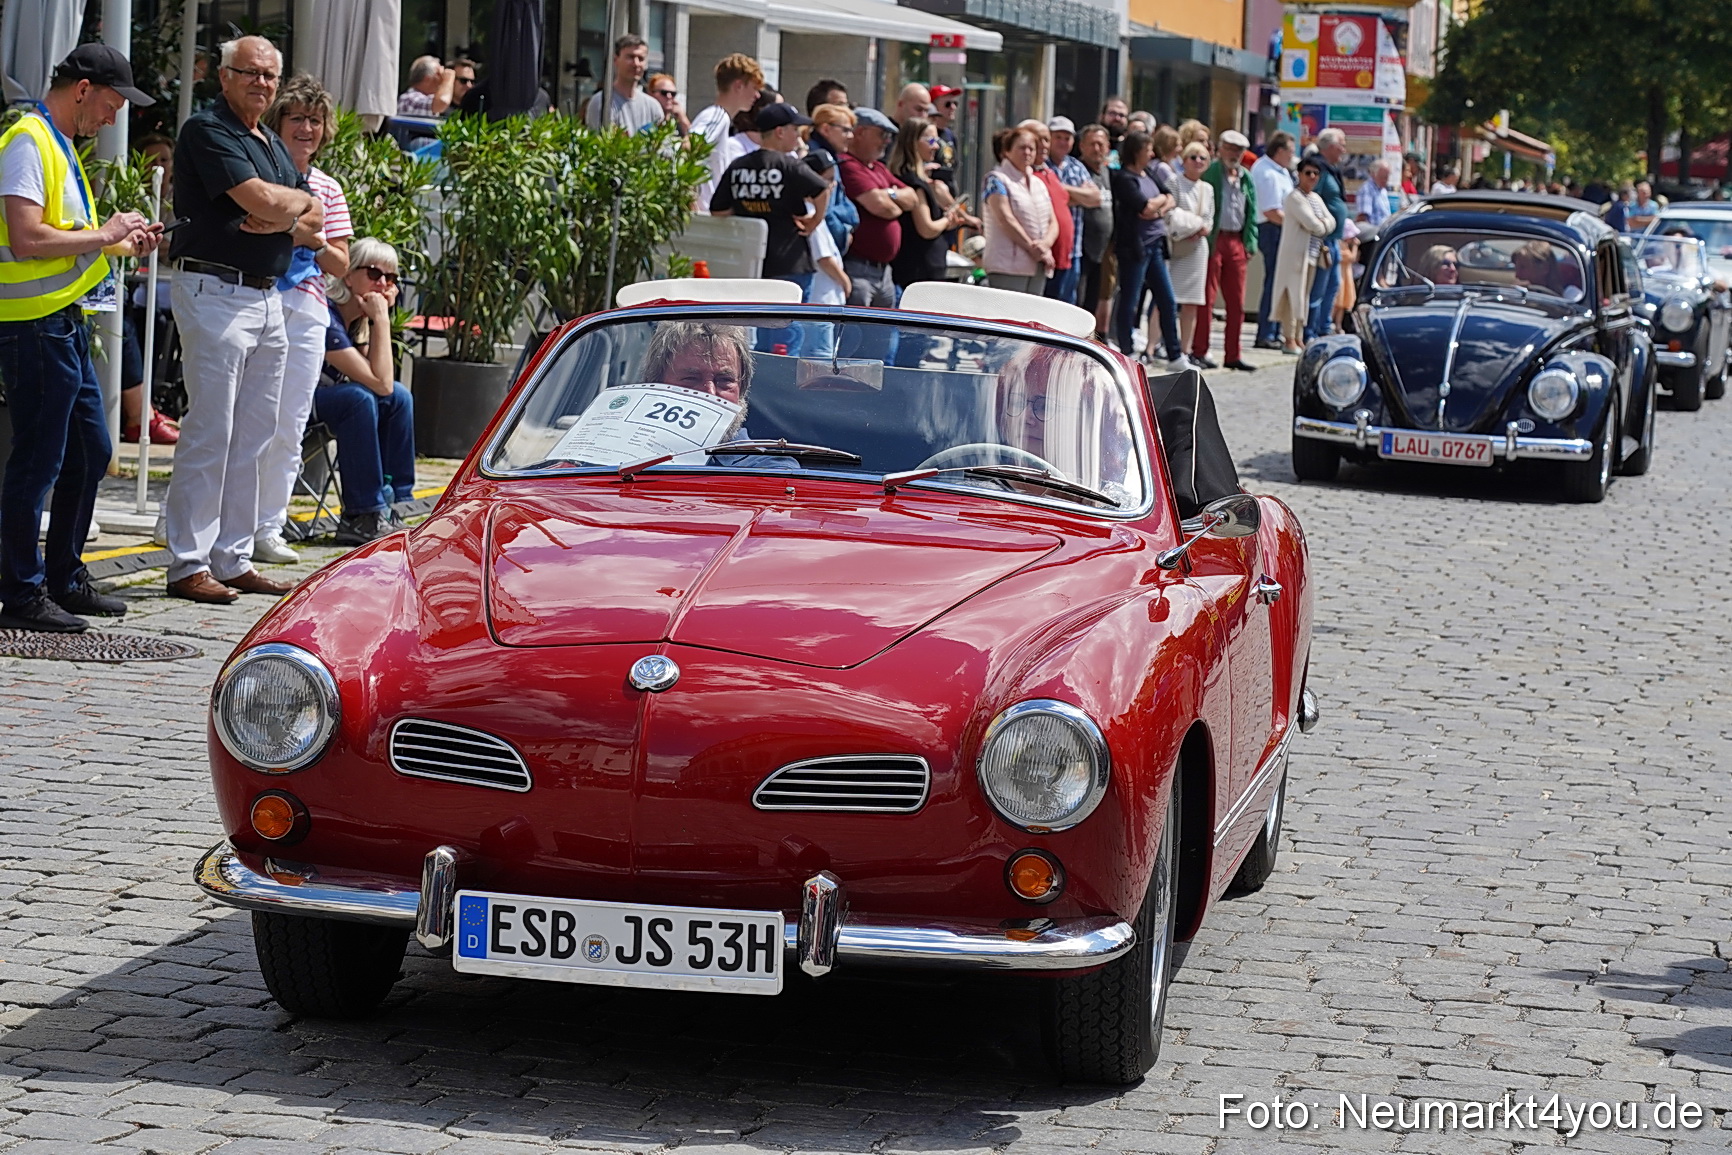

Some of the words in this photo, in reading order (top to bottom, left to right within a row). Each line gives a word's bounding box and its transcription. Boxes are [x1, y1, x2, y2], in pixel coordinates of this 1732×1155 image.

[731, 169, 757, 184] I'M
[758, 168, 783, 184] SO
[645, 402, 702, 430] 265
[1394, 437, 1429, 455] LAU
[1442, 441, 1487, 460] 0767
[467, 934, 479, 949] D
[491, 904, 577, 959] ESB
[615, 915, 673, 967] JS
[687, 920, 775, 973] 53H
